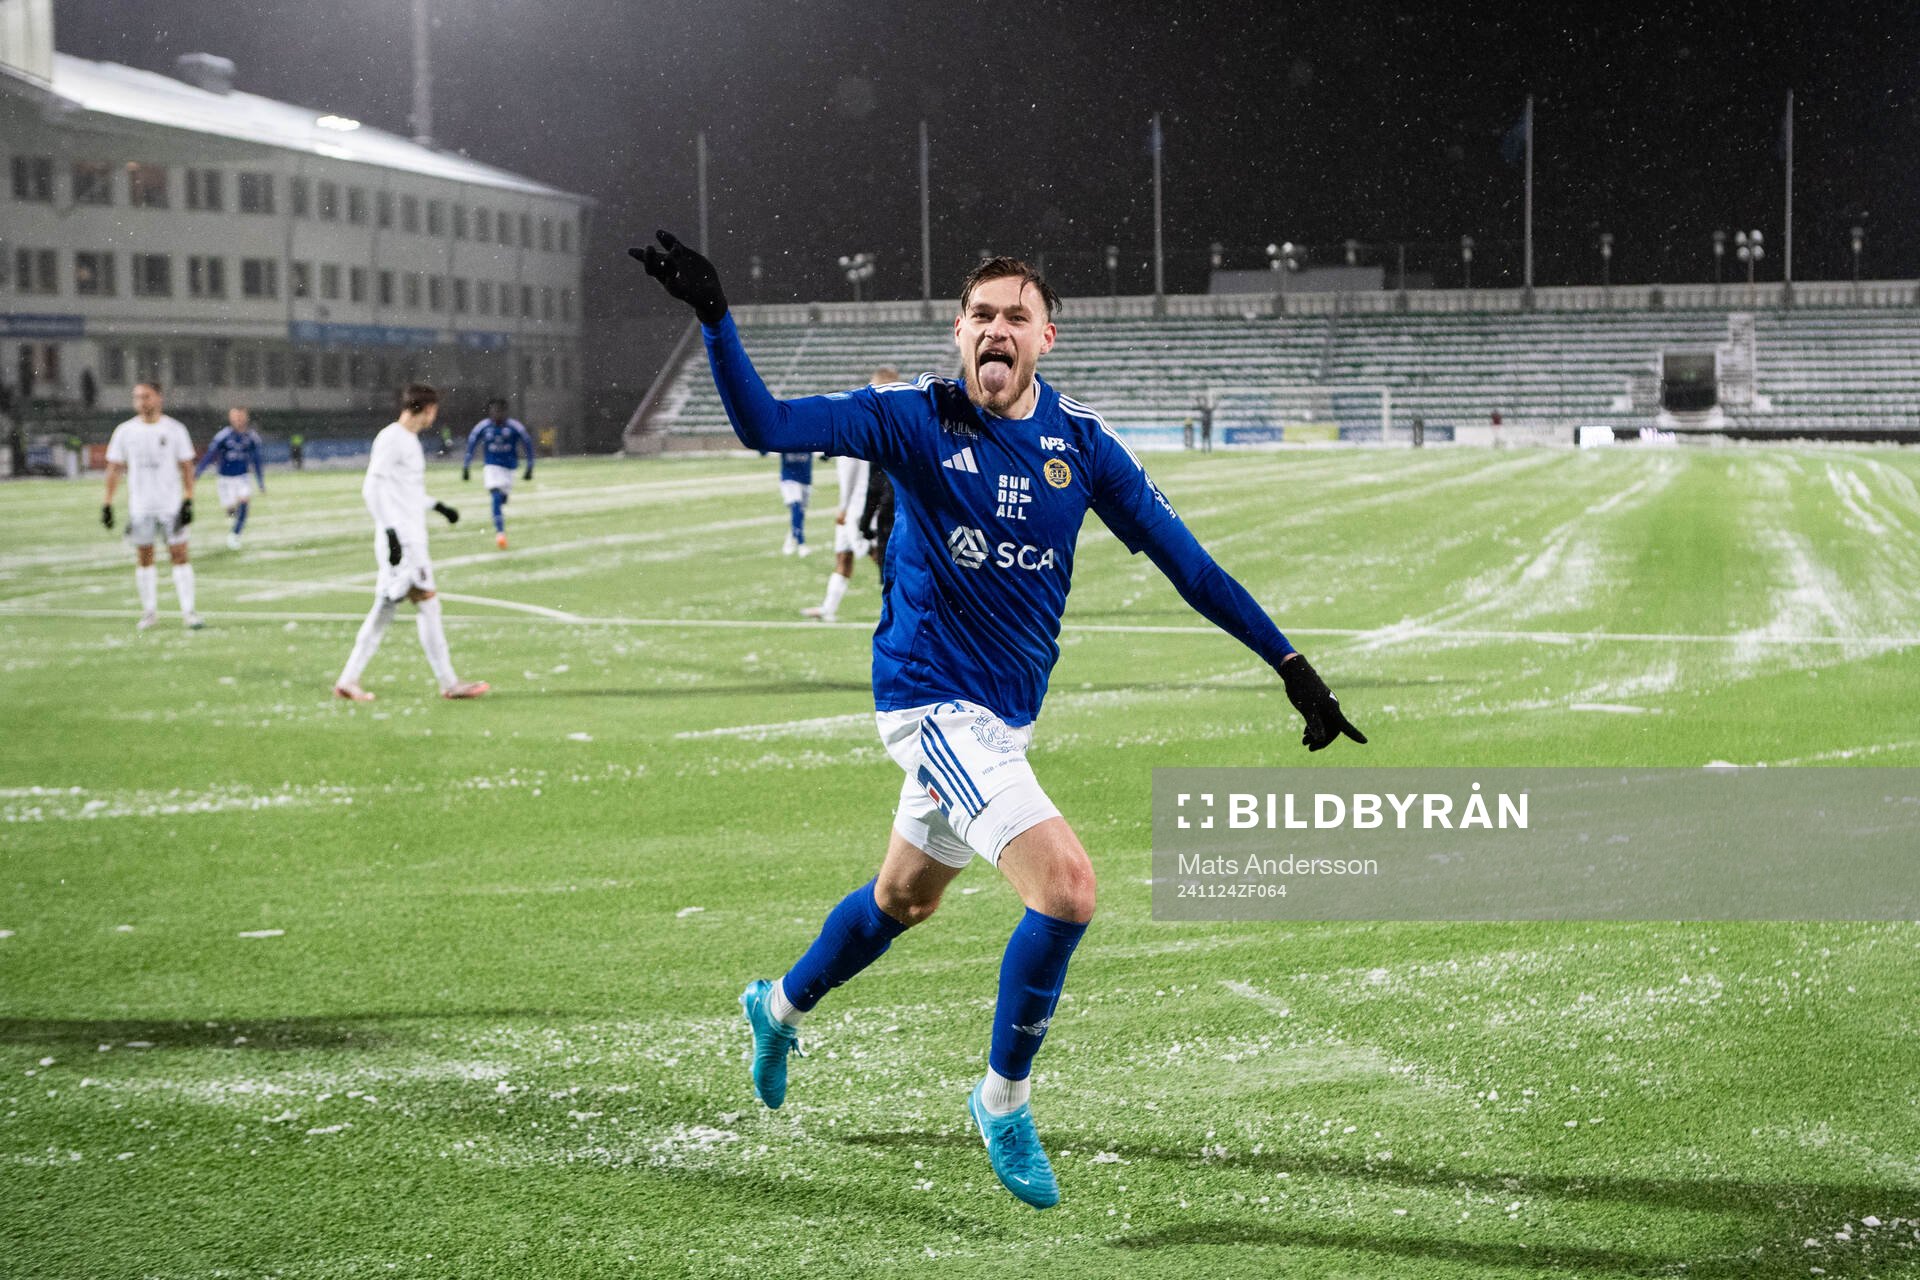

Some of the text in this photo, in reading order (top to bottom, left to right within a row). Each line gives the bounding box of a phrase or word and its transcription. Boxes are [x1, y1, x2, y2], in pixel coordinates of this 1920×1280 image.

[1040, 435, 1066, 451] NP3
[998, 475, 1030, 491] SUN
[996, 504, 1027, 520] ALL
[996, 542, 1054, 571] SCA
